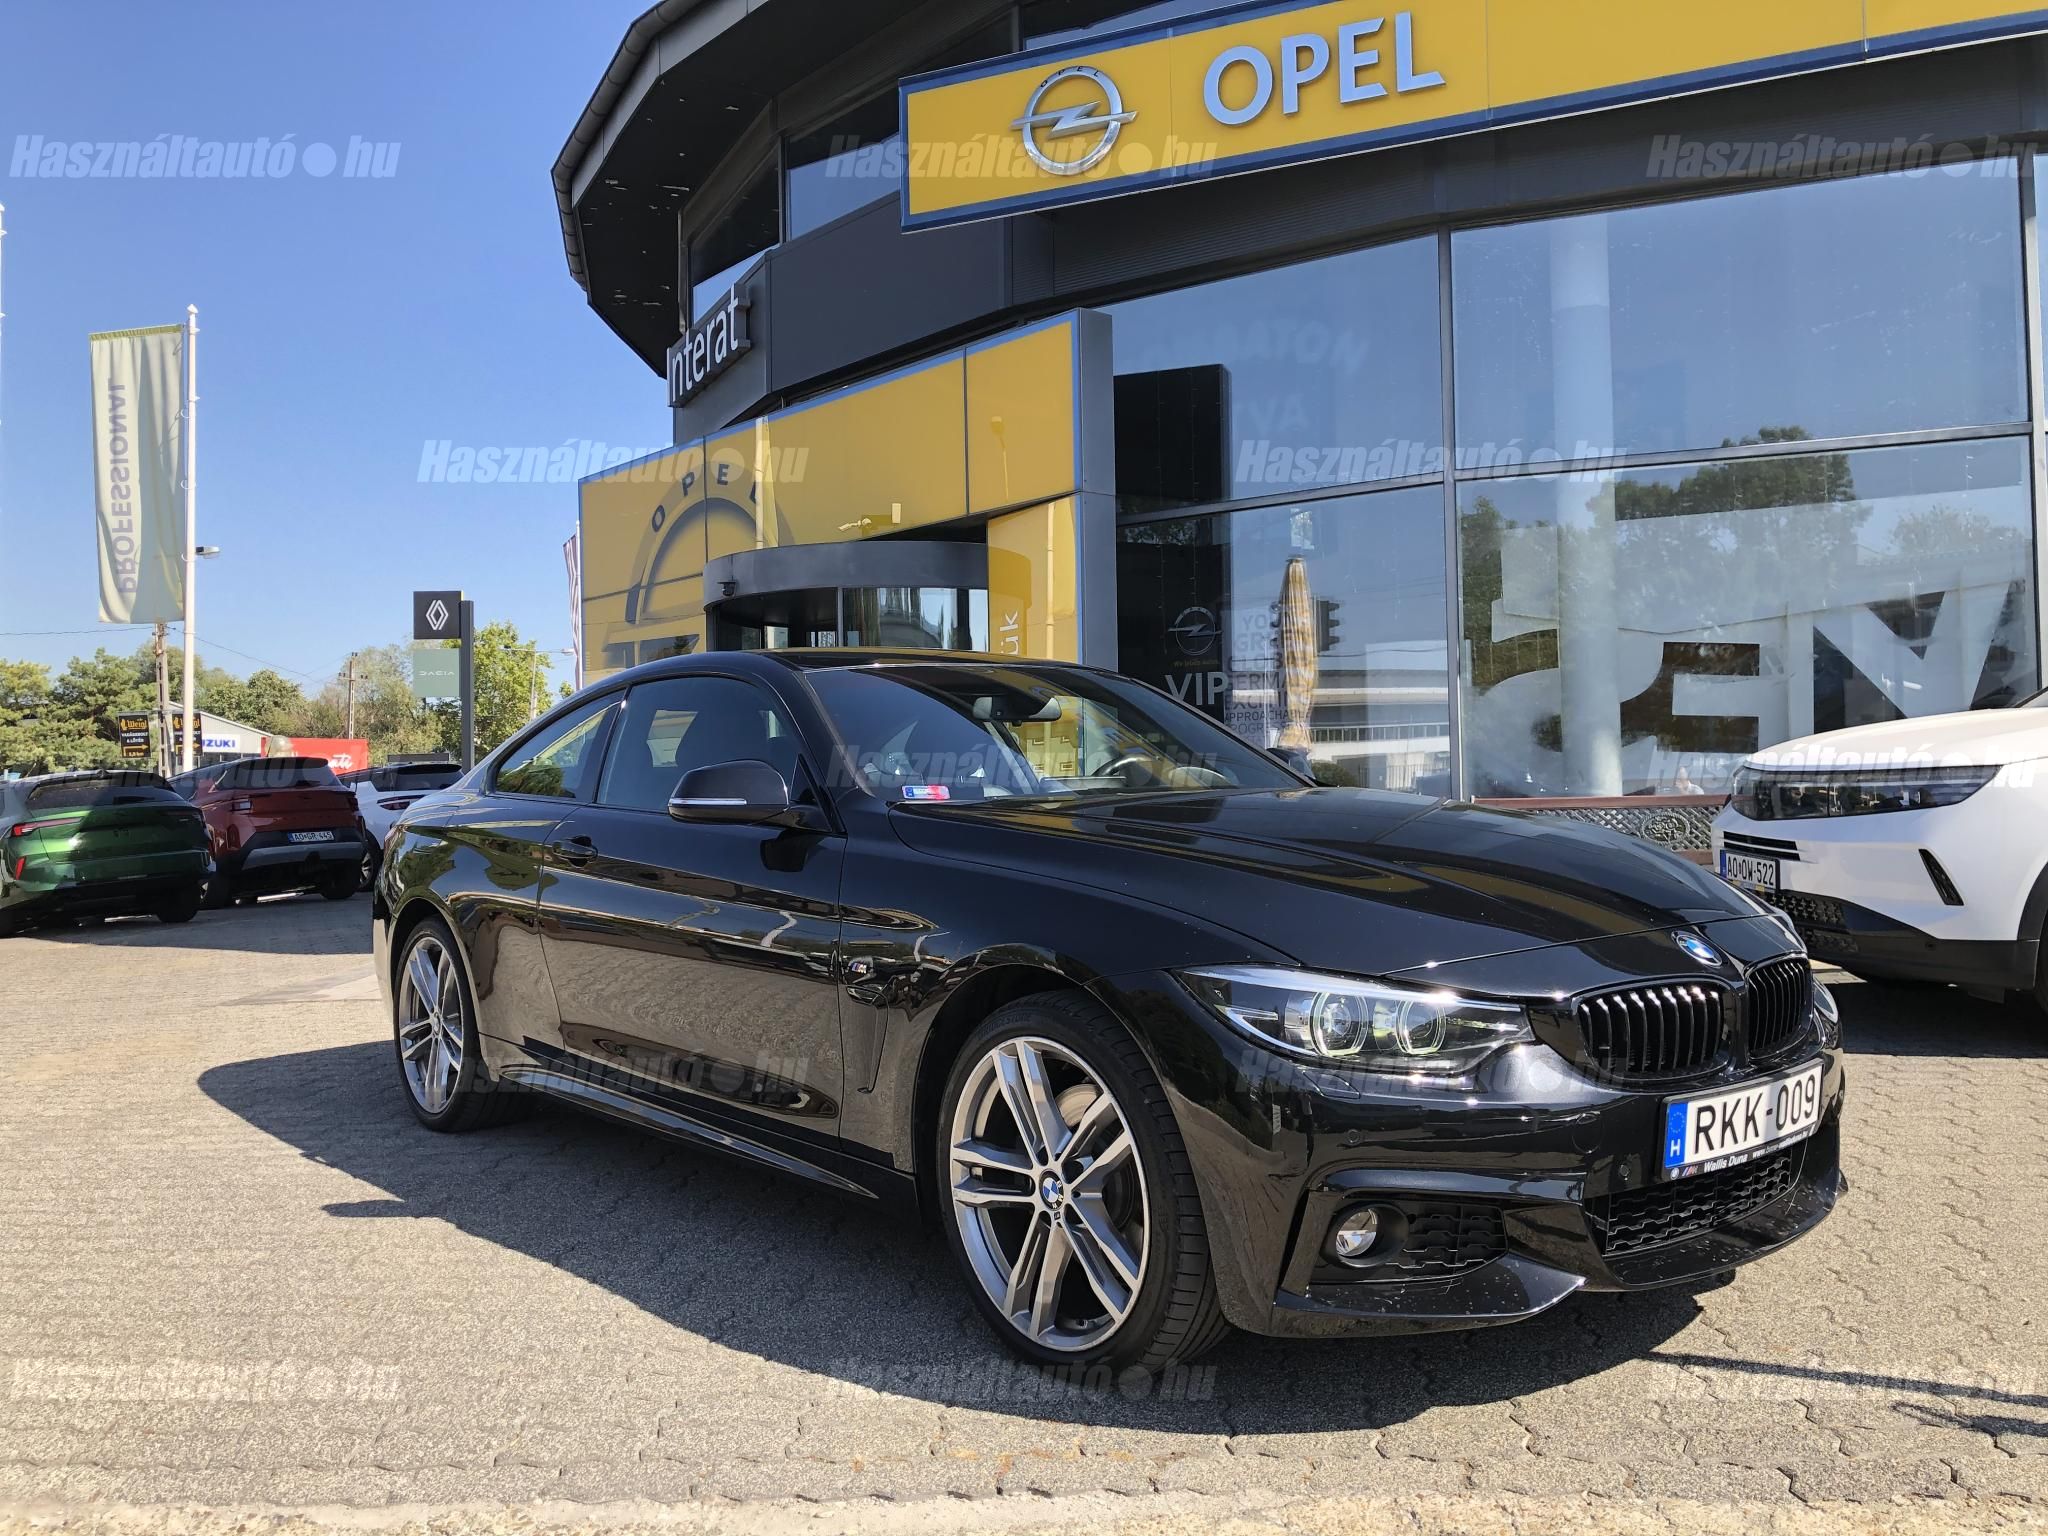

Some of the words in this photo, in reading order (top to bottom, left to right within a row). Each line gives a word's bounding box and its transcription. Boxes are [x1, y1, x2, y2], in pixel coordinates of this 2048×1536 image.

[1040, 66, 1100, 88] OPEL
[1203, 11, 1446, 125] OPEL
[667, 283, 738, 407] Interat
[1165, 672, 1229, 705] VIP
[1695, 1074, 1816, 1154] RKK-009
[1670, 1139, 1681, 1157] H
[1704, 1159, 1727, 1173] Wallis
[1728, 1153, 1748, 1167] Duna
